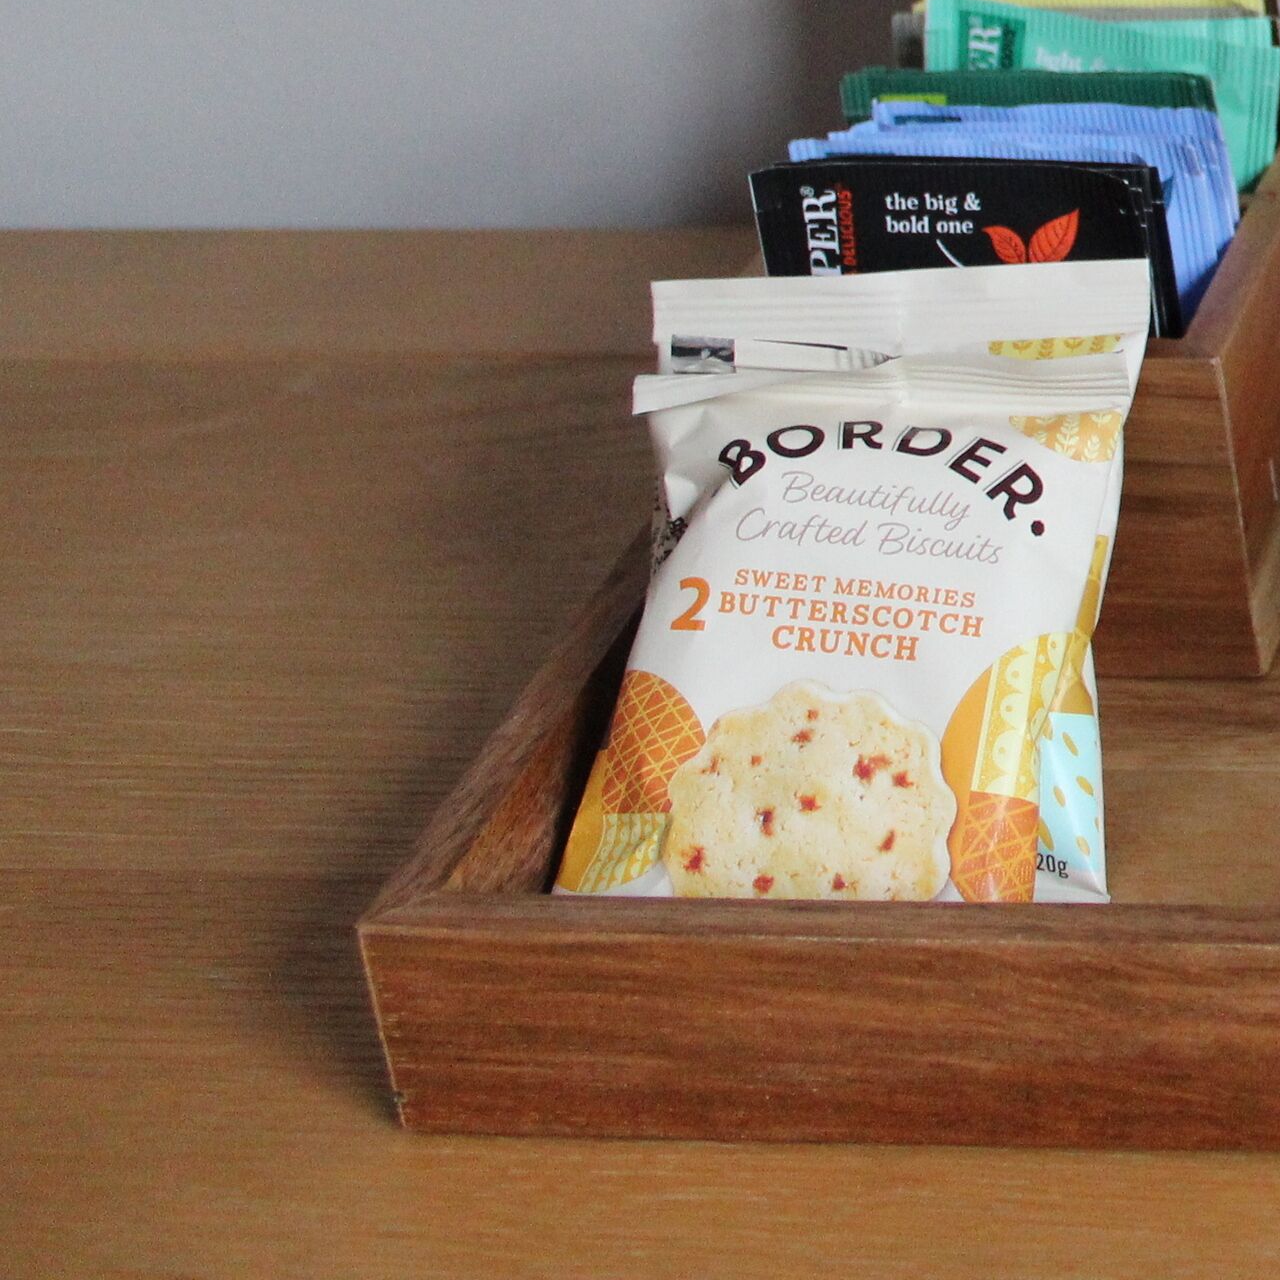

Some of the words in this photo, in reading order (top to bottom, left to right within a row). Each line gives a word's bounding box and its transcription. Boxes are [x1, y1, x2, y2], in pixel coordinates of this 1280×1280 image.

[884, 192, 919, 211] the
[924, 192, 959, 214] big
[963, 192, 982, 212] &
[885, 215, 931, 234] bold
[935, 221, 974, 234] one
[781, 470, 972, 531] Beautifully
[736, 508, 869, 546] Crafted
[877, 522, 1004, 565] Biscuits
[670, 576, 711, 631] 2
[735, 568, 827, 593] SWEET
[834, 577, 977, 608] MEMORIES
[718, 591, 985, 637] BUTTERSCOTCH
[771, 624, 920, 661] CRUNCH
[1036, 852, 1069, 879] 20g
